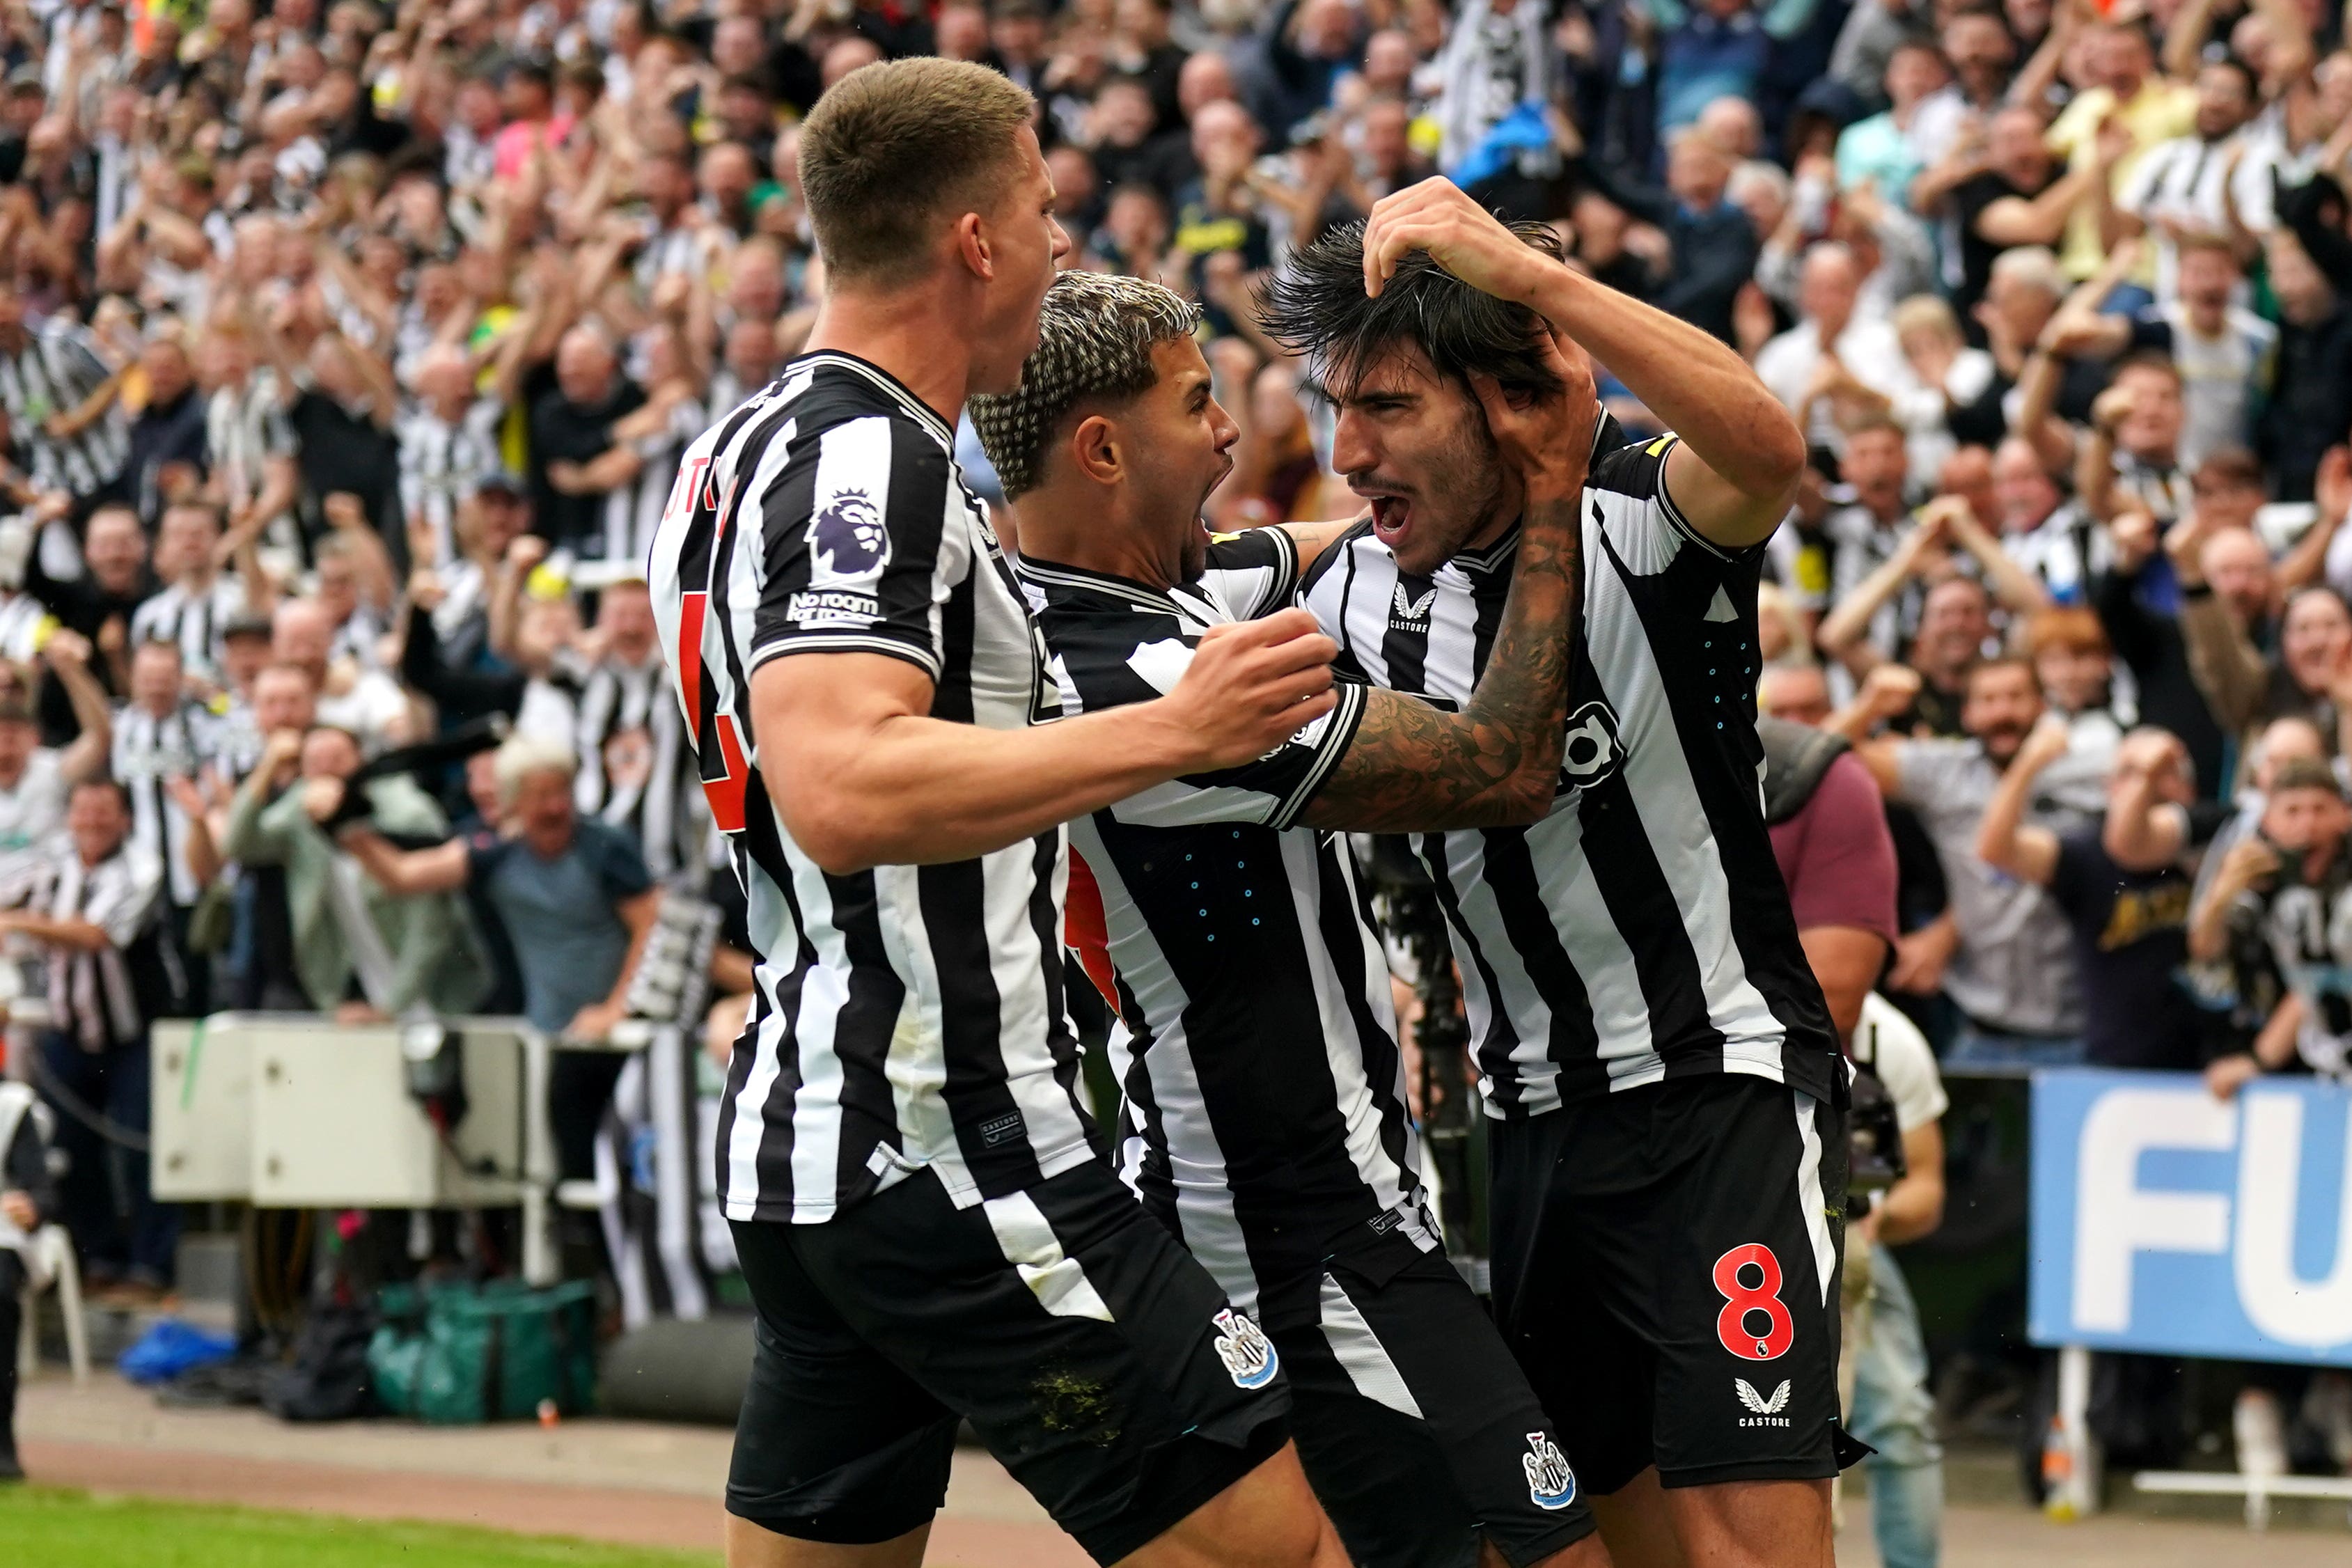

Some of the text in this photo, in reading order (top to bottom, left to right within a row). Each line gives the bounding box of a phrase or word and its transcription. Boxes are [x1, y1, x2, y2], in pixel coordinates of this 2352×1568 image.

[790, 592, 879, 616] No room
[1390, 619, 1428, 633] CASTORE
[2071, 1085, 2352, 1348] FU
[1712, 1242, 1794, 1361] 8
[1739, 1416, 1791, 1428] CASTORE
